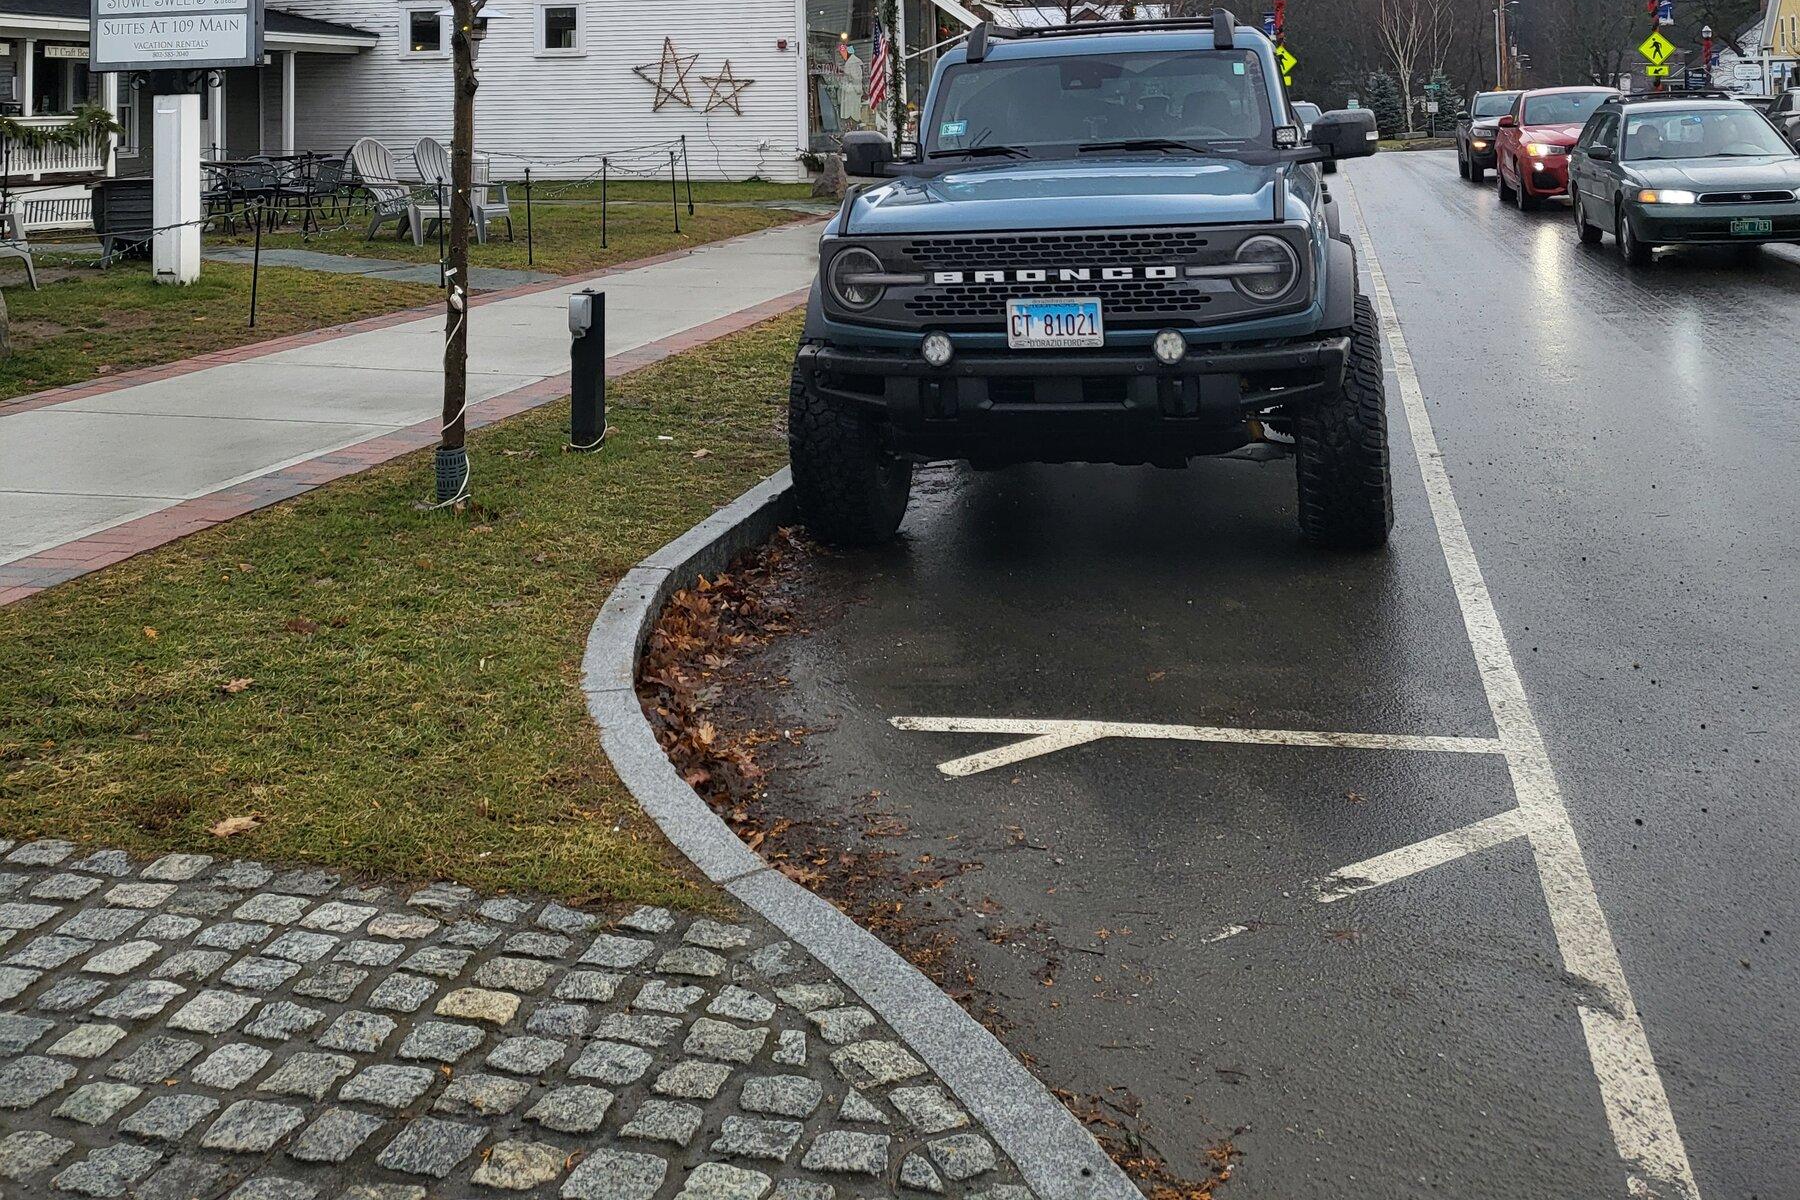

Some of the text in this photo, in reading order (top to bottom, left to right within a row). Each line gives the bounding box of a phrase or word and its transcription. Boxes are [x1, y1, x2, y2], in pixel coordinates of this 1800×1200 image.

[103, 21, 145, 35] SUITES
[173, 20, 194, 33] 109
[199, 18, 239, 31] MAIN
[47, 47, 58, 56] VT
[60, 47, 76, 56] Craft
[133, 39, 209, 50] VACATION RENTALS
[934, 265, 1177, 284] BRONCO
[1012, 312, 1098, 337] CT 81021
[1063, 339, 1082, 347] FORD
